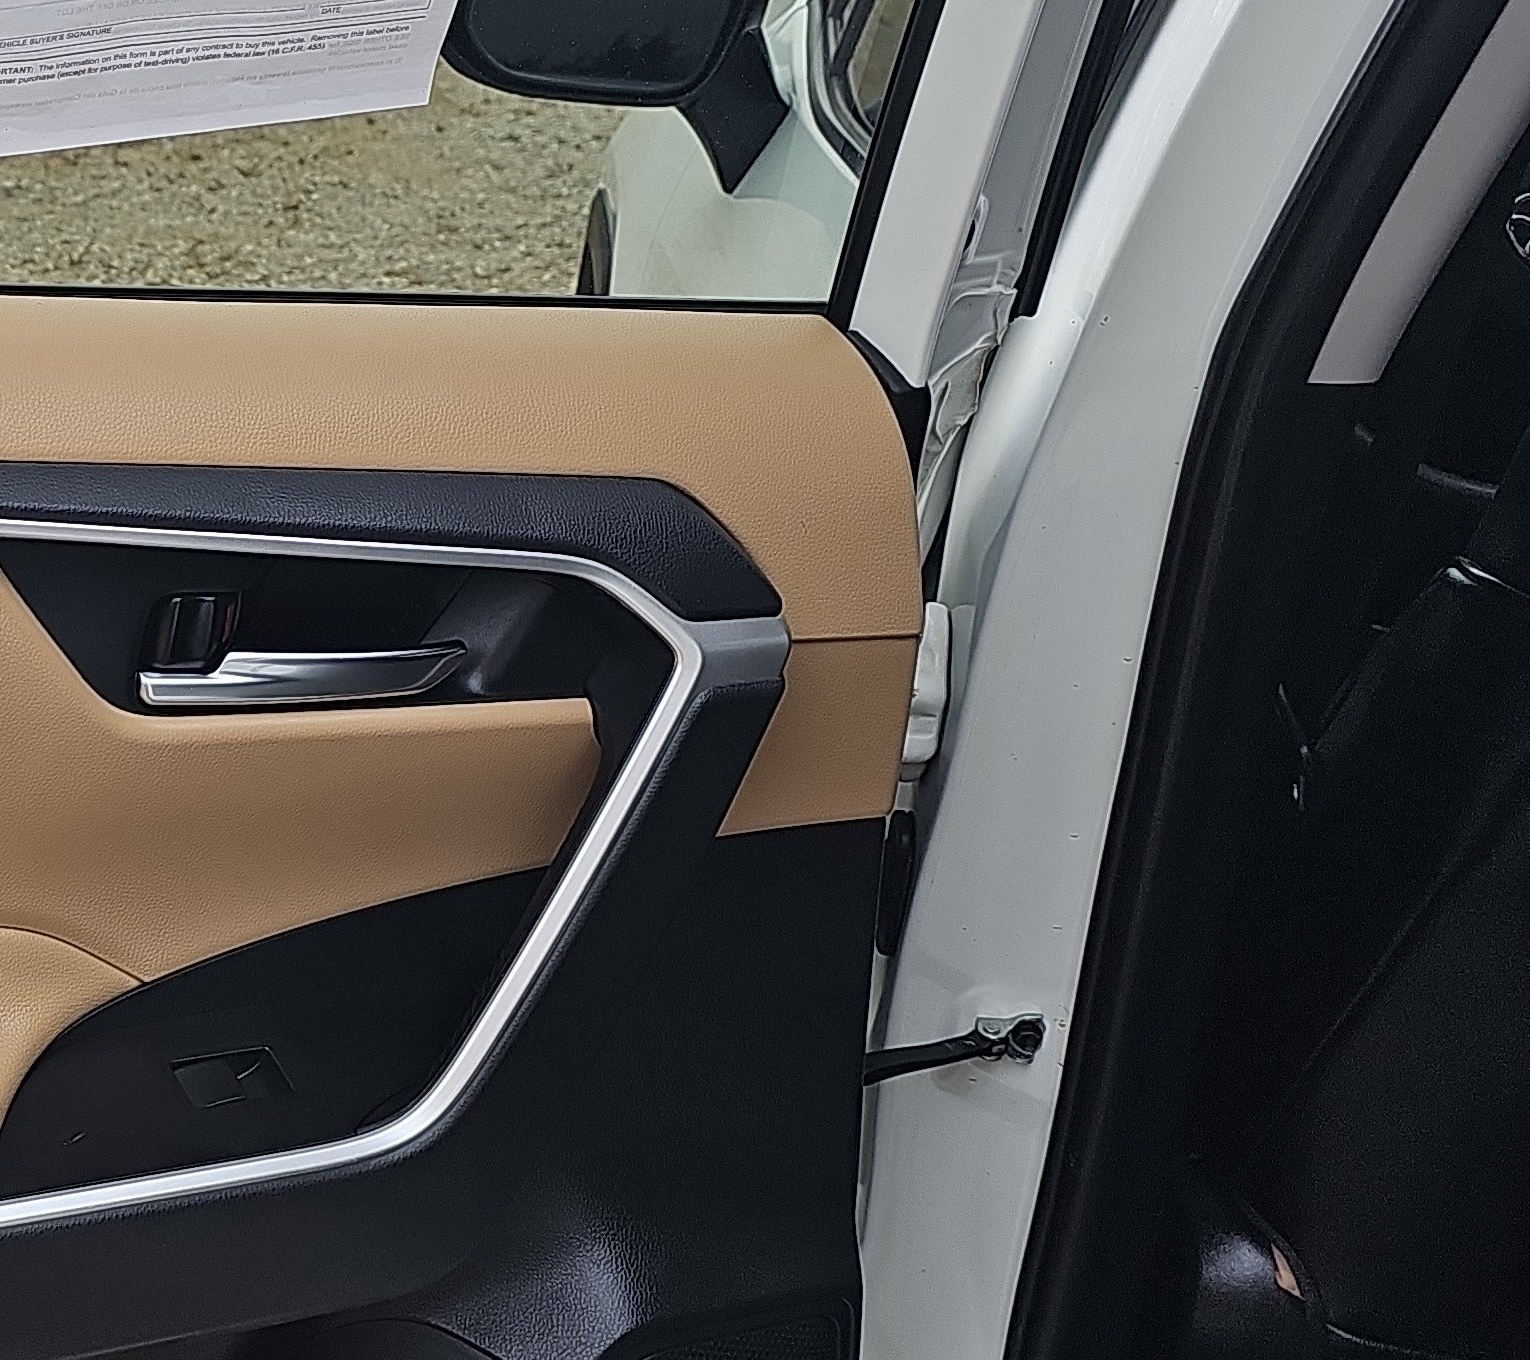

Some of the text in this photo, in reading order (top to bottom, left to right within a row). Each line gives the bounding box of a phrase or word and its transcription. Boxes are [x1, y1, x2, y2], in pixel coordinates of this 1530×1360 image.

[321, 7, 342, 15] DATE
[30, 34, 65, 45] BUYER'S
[66, 27, 113, 41] SIGNATURE
[39, 63, 54, 72] The
[55, 57, 100, 70] information
[113, 53, 128, 62] this
[129, 51, 148, 60] form
[150, 50, 156, 58] is
[157, 47, 175, 59] part
[175, 46, 185, 55] of
[185, 46, 200, 54] any
[202, 42, 234, 52] contract
[235, 41, 244, 49] to
[245, 40, 259, 49] buy
[262, 38, 276, 47] this
[310, 31, 349, 42] Removing
[350, 29, 364, 38] this
[366, 27, 385, 36] label
[386, 25, 410, 34] before
[17, 71, 56, 84] purchase
[57, 68, 87, 78] (except
[87, 66, 99, 75] for
[100, 63, 132, 75] purpose
[133, 60, 143, 69] of
[192, 52, 222, 62] violates
[223, 50, 250, 60] federal
[252, 49, 267, 58] law
